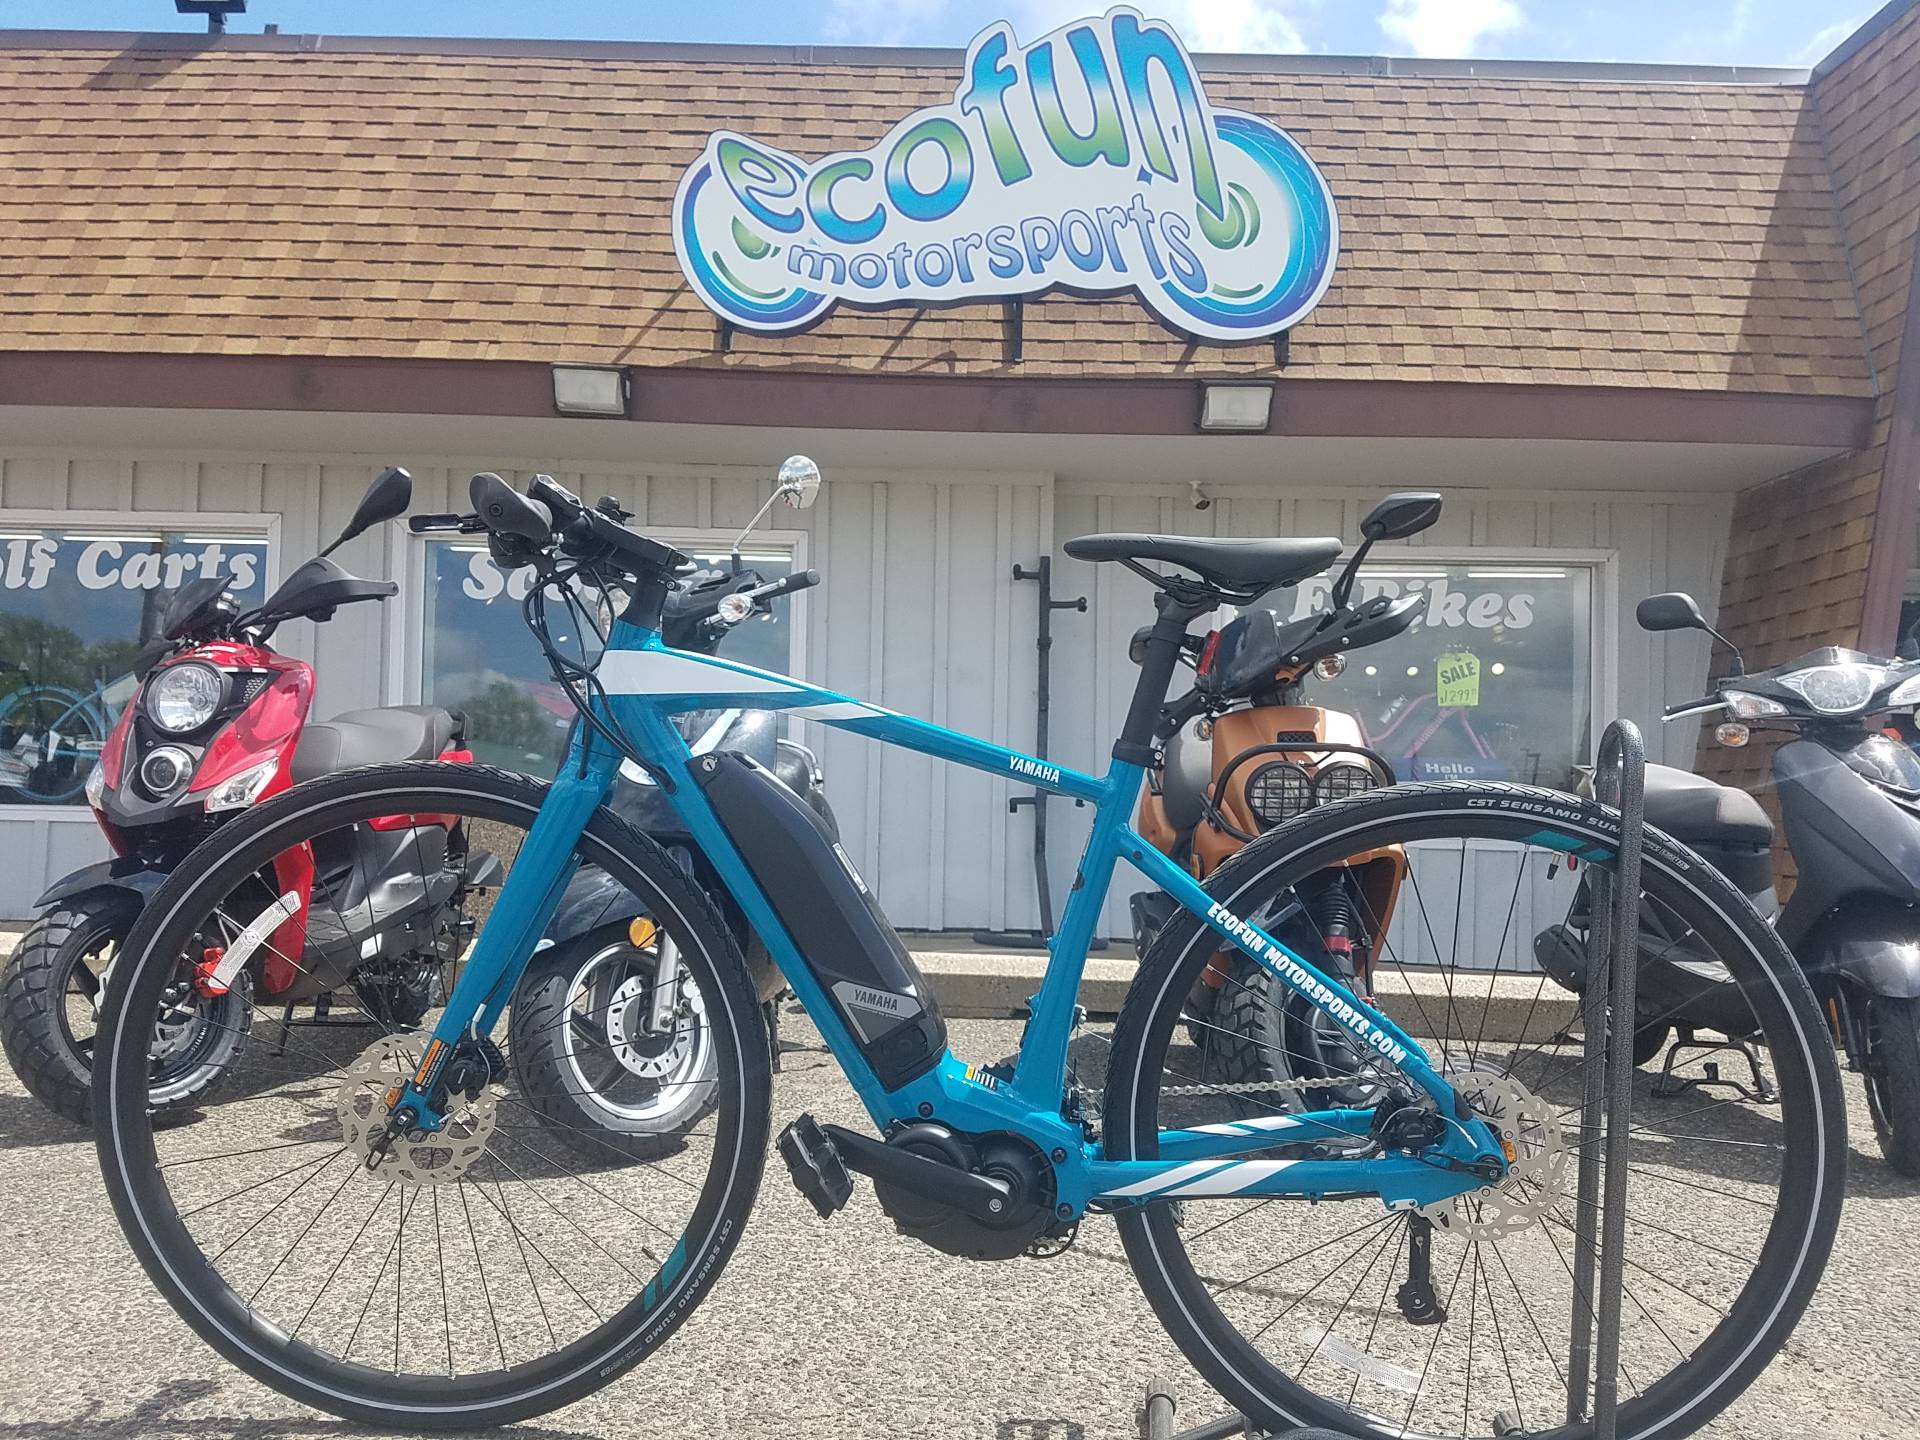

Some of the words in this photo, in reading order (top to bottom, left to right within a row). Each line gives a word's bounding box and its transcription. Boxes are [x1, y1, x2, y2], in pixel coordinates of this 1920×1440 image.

[787, 193, 1208, 296] motorsports
[0, 539, 58, 590] lf
[77, 542, 258, 590] Carts
[1440, 661, 1477, 685] SALE
[1009, 755, 1060, 783] YAMAHA
[1425, 762, 1475, 774] Hello
[1467, 798, 1497, 807] CST
[1499, 799, 1583, 821] SENSAMO
[1586, 816, 1621, 834] SUM
[854, 989, 899, 1012] YAMAHA
[1207, 901, 1268, 953] ECOFUN
[1263, 944, 1407, 1065] MOTORSPORTS.COM
[720, 1218, 733, 1244] CST
[678, 1244, 720, 1309] SENSAMO
[644, 1309, 677, 1344] SUMO
